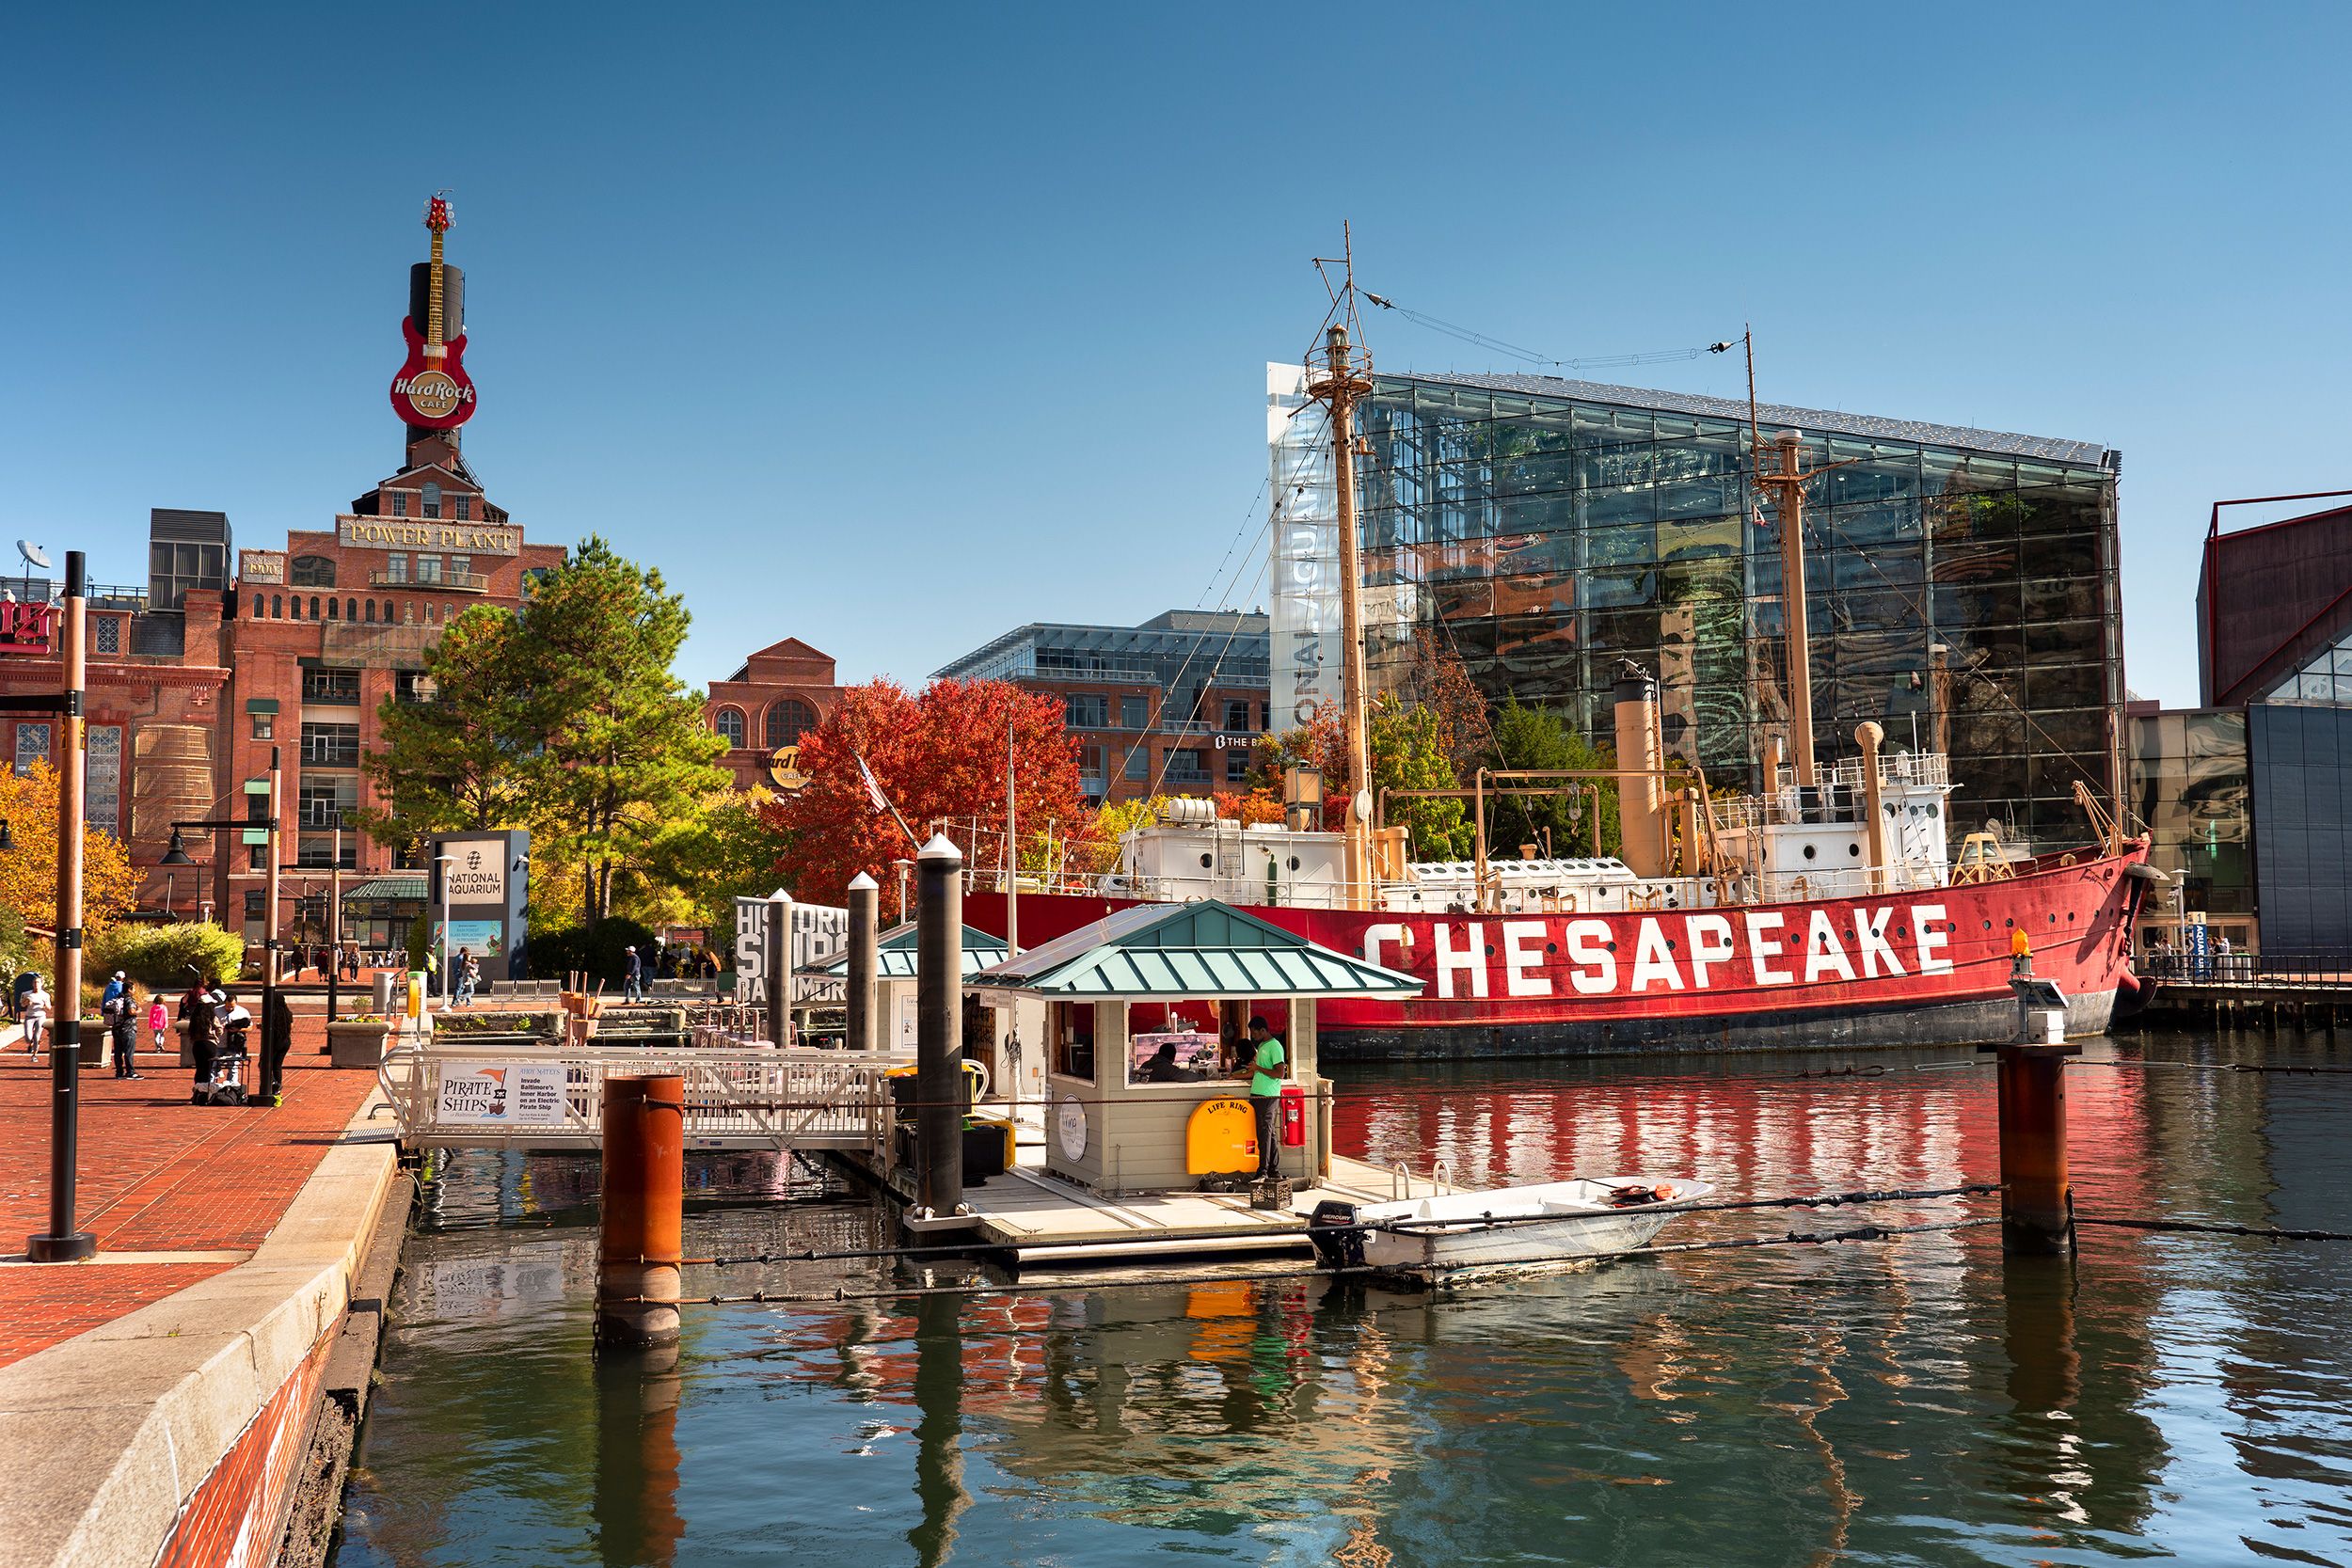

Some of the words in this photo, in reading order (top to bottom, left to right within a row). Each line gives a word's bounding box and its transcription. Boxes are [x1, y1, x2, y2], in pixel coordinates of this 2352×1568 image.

[395, 378, 435, 396] Hard
[436, 381, 473, 403] Rock
[420, 400, 448, 408] CAFE
[351, 525, 430, 546] POWER
[439, 529, 513, 550] PLANT
[249, 563, 278, 576] 1900
[1227, 737, 1247, 746] THE
[450, 873, 501, 883] NATIONAL
[449, 884, 501, 895] AQUARIUM
[738, 905, 848, 933] HIORI
[1363, 904, 1955, 998] CHESAPEAKE
[2196, 925, 2204, 973] AQUARU
[738, 977, 847, 1002] BAIMOR
[444, 1080, 492, 1098] PIRATE
[443, 1097, 487, 1111] SHIPS
[1208, 1101, 1226, 1115] LIFE
[1230, 1101, 1248, 1114] RING
